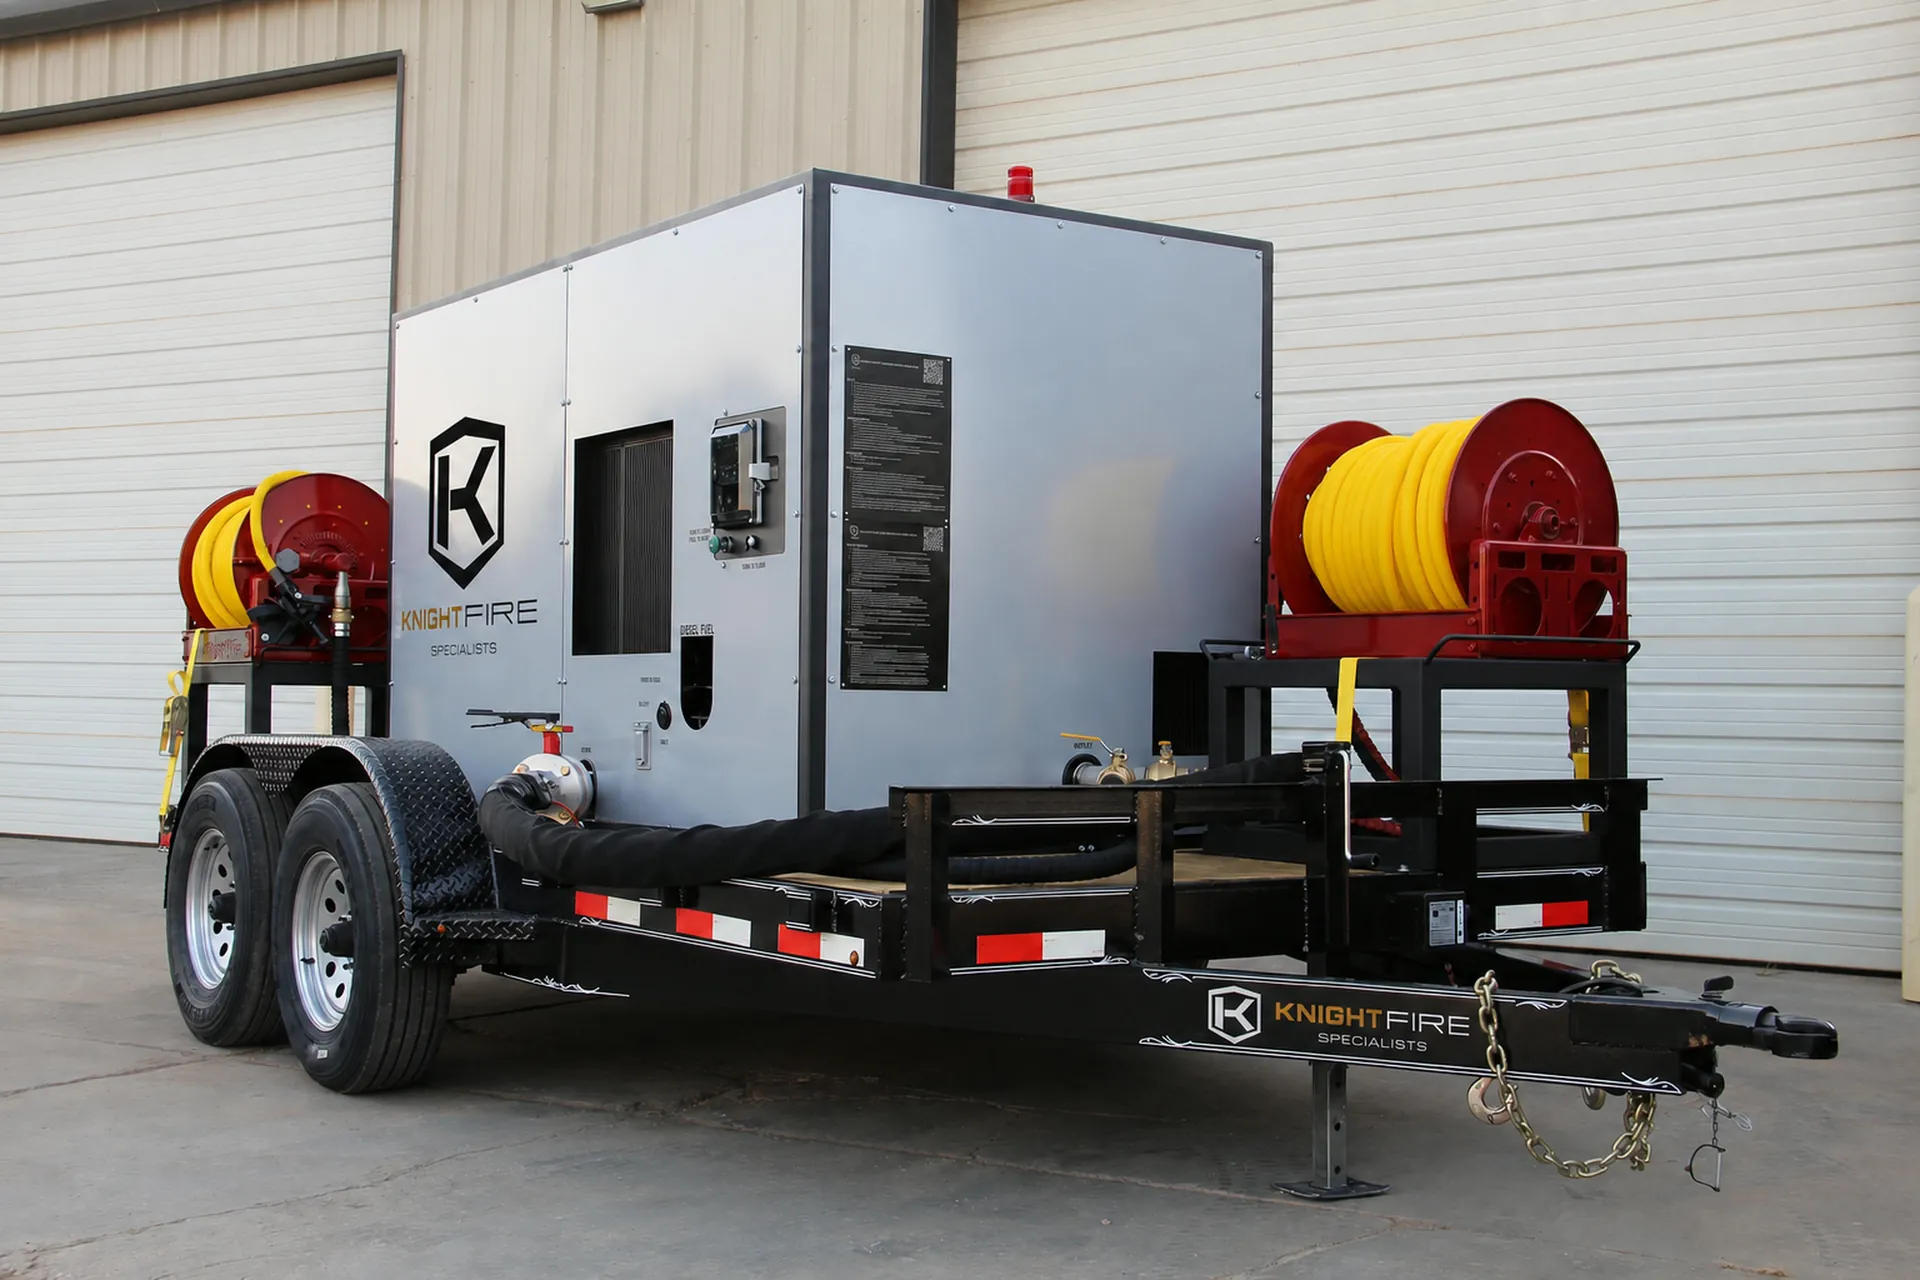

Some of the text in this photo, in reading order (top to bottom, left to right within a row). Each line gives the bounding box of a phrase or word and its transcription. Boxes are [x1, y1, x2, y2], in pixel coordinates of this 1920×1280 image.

[401, 599, 538, 632] KNIGHTFIRE
[680, 623, 715, 636] DIESEL FUEL
[430, 641, 498, 657] SPECIALISTS
[1275, 1001, 1471, 1037] KNIGHTFIRE
[1317, 1031, 1428, 1053] SPECIALISTS
